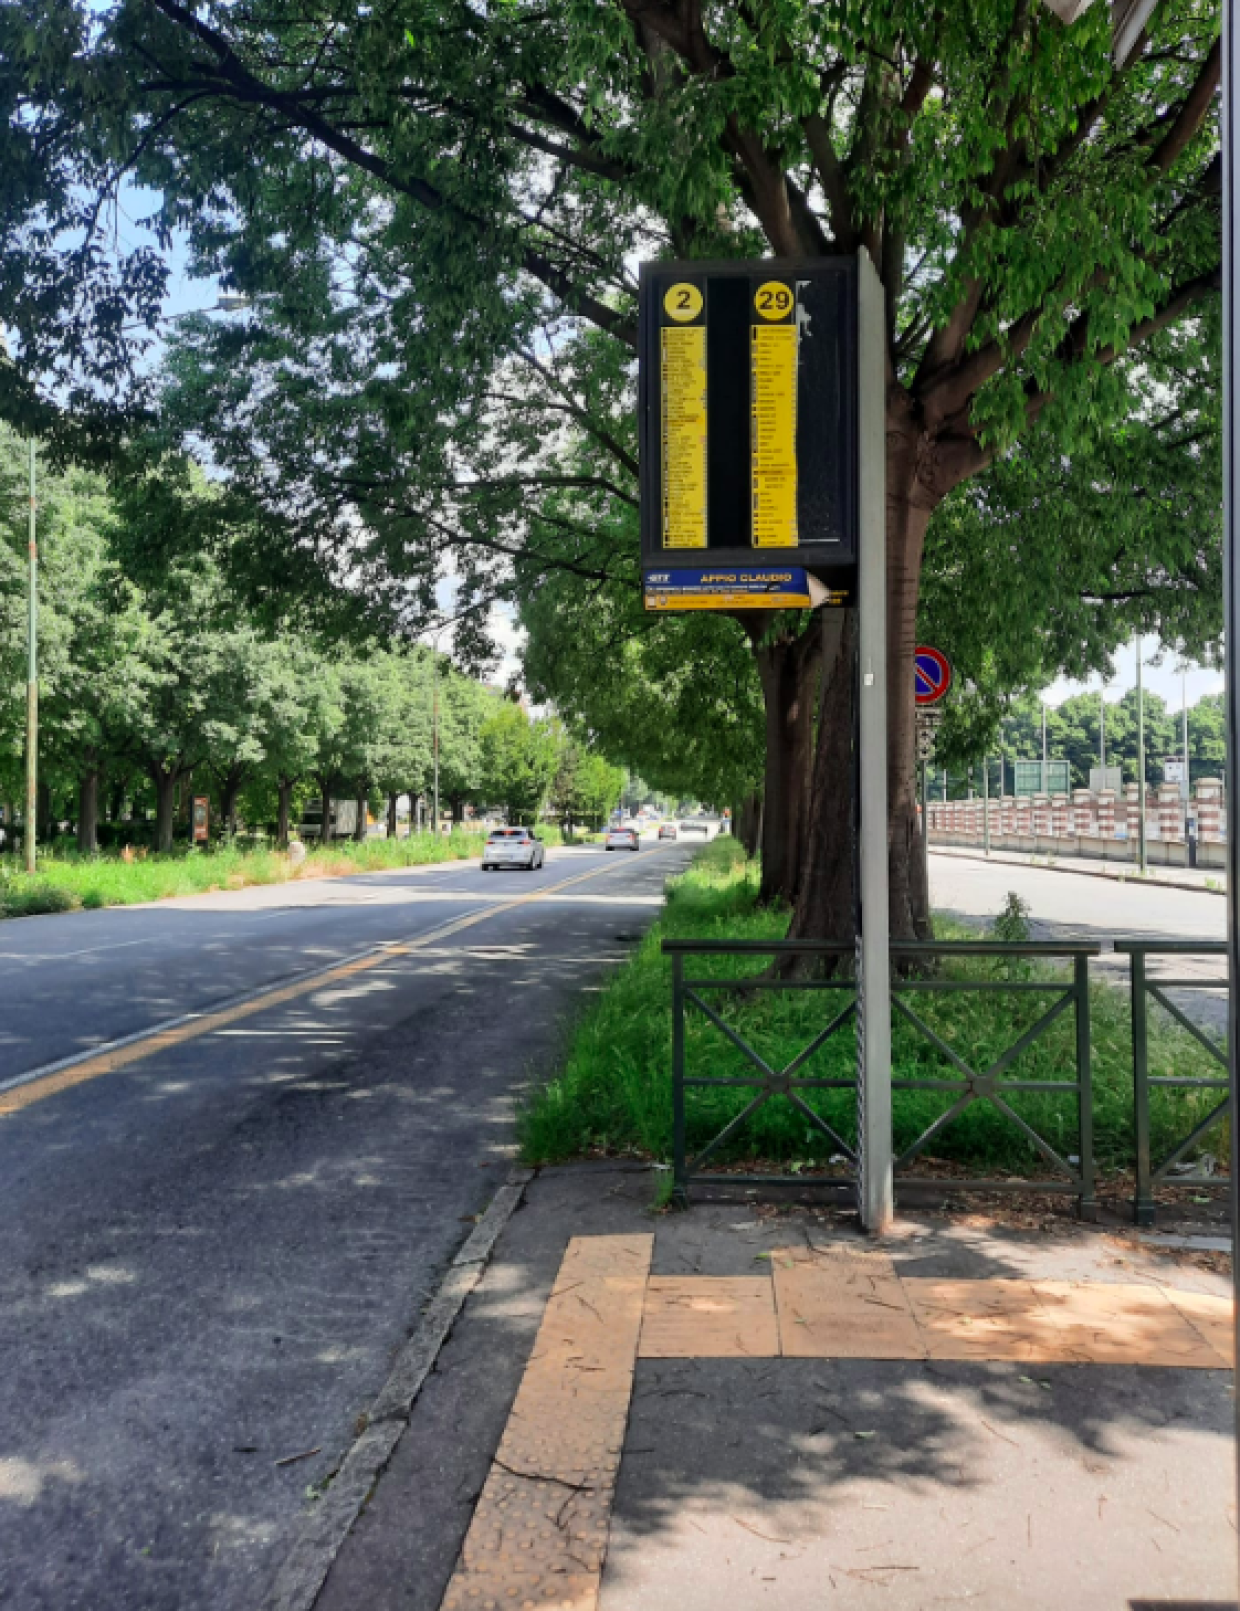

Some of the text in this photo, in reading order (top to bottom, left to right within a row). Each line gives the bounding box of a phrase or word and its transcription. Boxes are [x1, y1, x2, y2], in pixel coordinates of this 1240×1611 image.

[675, 289, 691, 310] 2
[759, 290, 790, 310] 29
[740, 572, 792, 582] CLAUDIO
